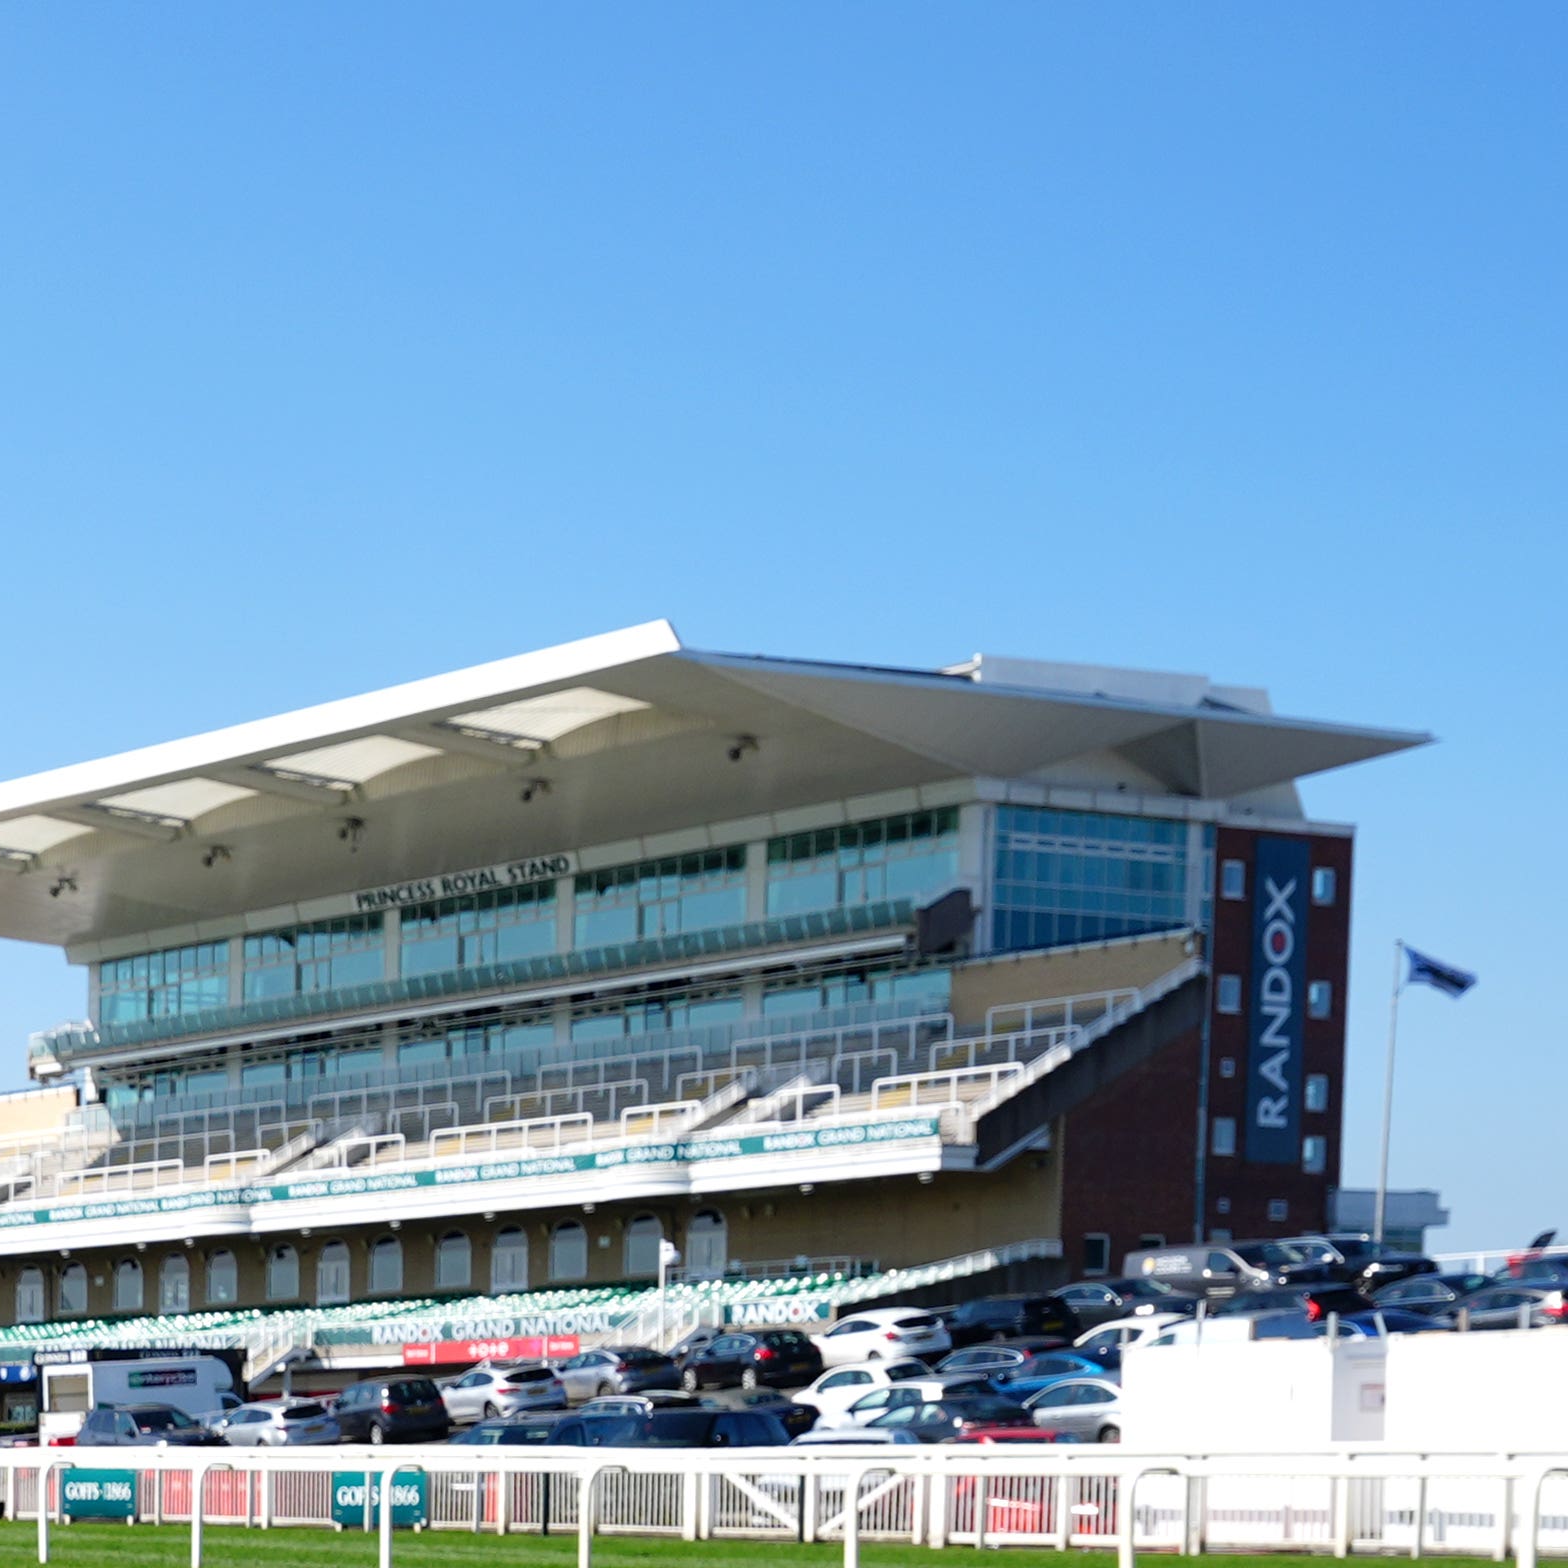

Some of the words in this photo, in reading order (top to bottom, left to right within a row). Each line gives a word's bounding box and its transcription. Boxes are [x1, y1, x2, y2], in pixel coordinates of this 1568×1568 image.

[356, 881, 436, 911] PRINCESS
[442, 870, 500, 896] ROYAL
[507, 856, 570, 883] STAND
[1256, 876, 1297, 1129] RANDOX
[372, 1320, 443, 1345] RANDOX
[452, 1317, 515, 1341] GRAND
[520, 1312, 613, 1336] NATIONAL
[732, 1301, 820, 1325] RANDOX
[336, 1485, 379, 1506] GOFS
